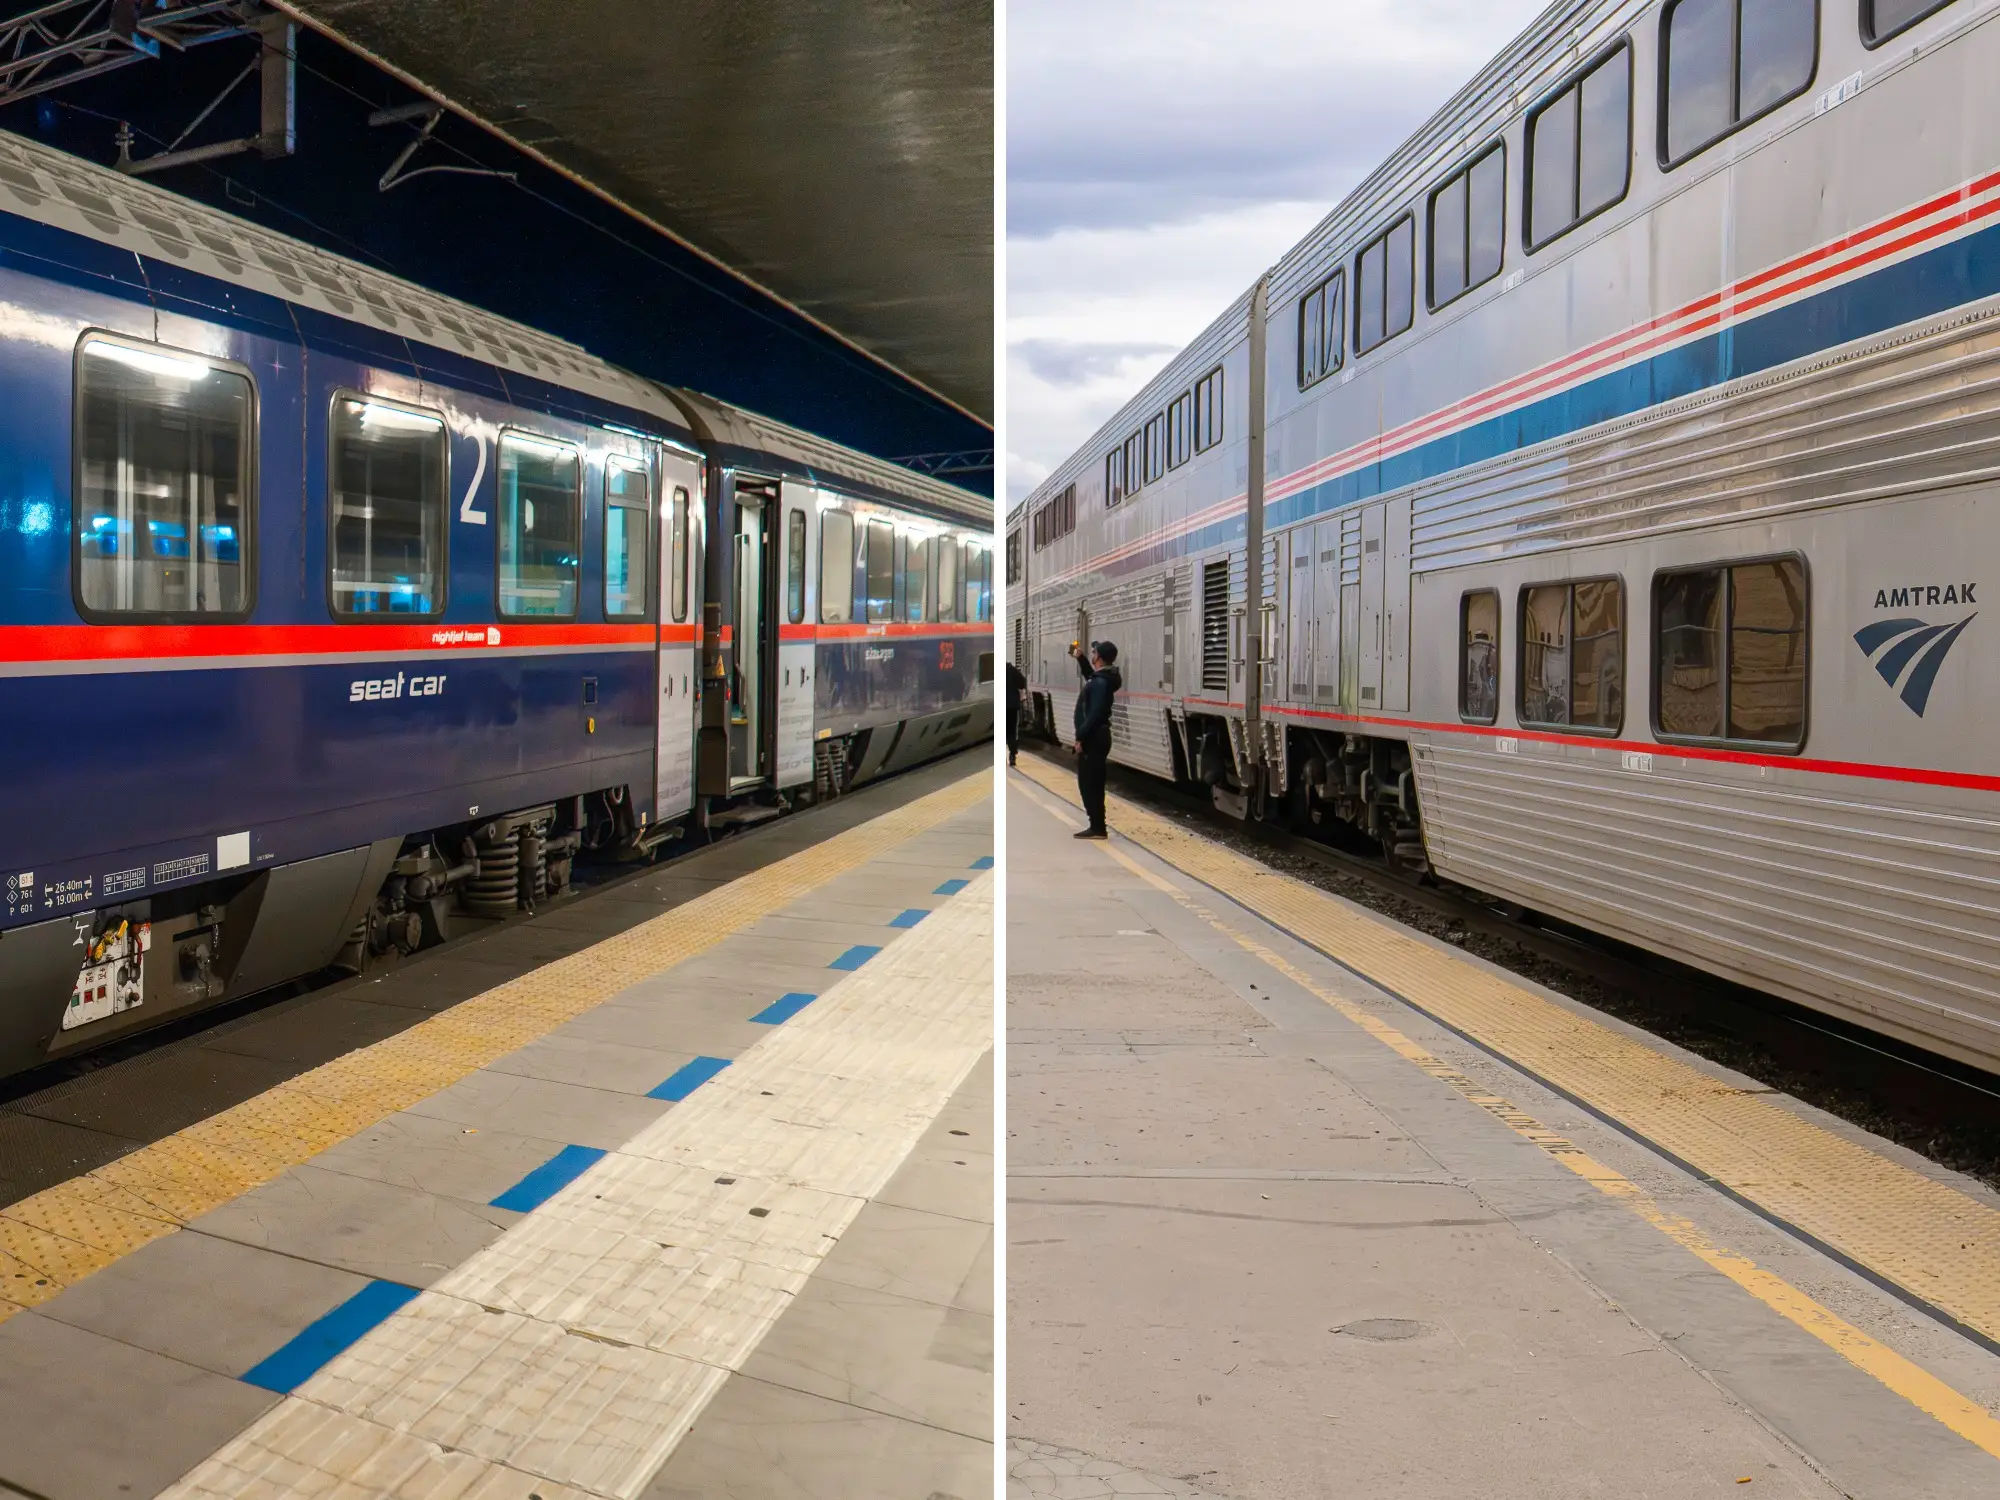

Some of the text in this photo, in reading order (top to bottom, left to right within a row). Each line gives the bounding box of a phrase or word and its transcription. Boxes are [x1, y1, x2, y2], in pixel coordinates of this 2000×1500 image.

[460, 424, 487, 525] 2
[1873, 582, 1977, 609] AMTRAK
[349, 671, 447, 702] seat car
[20, 890, 29, 900] 76
[54, 880, 83, 894] 26.40m
[55, 892, 83, 906] 19.00m
[9, 907, 15, 916] P
[20, 904, 29, 914] 60
[1479, 1101, 1549, 1131] YELLOW
[1527, 1135, 1585, 1155] LINE
